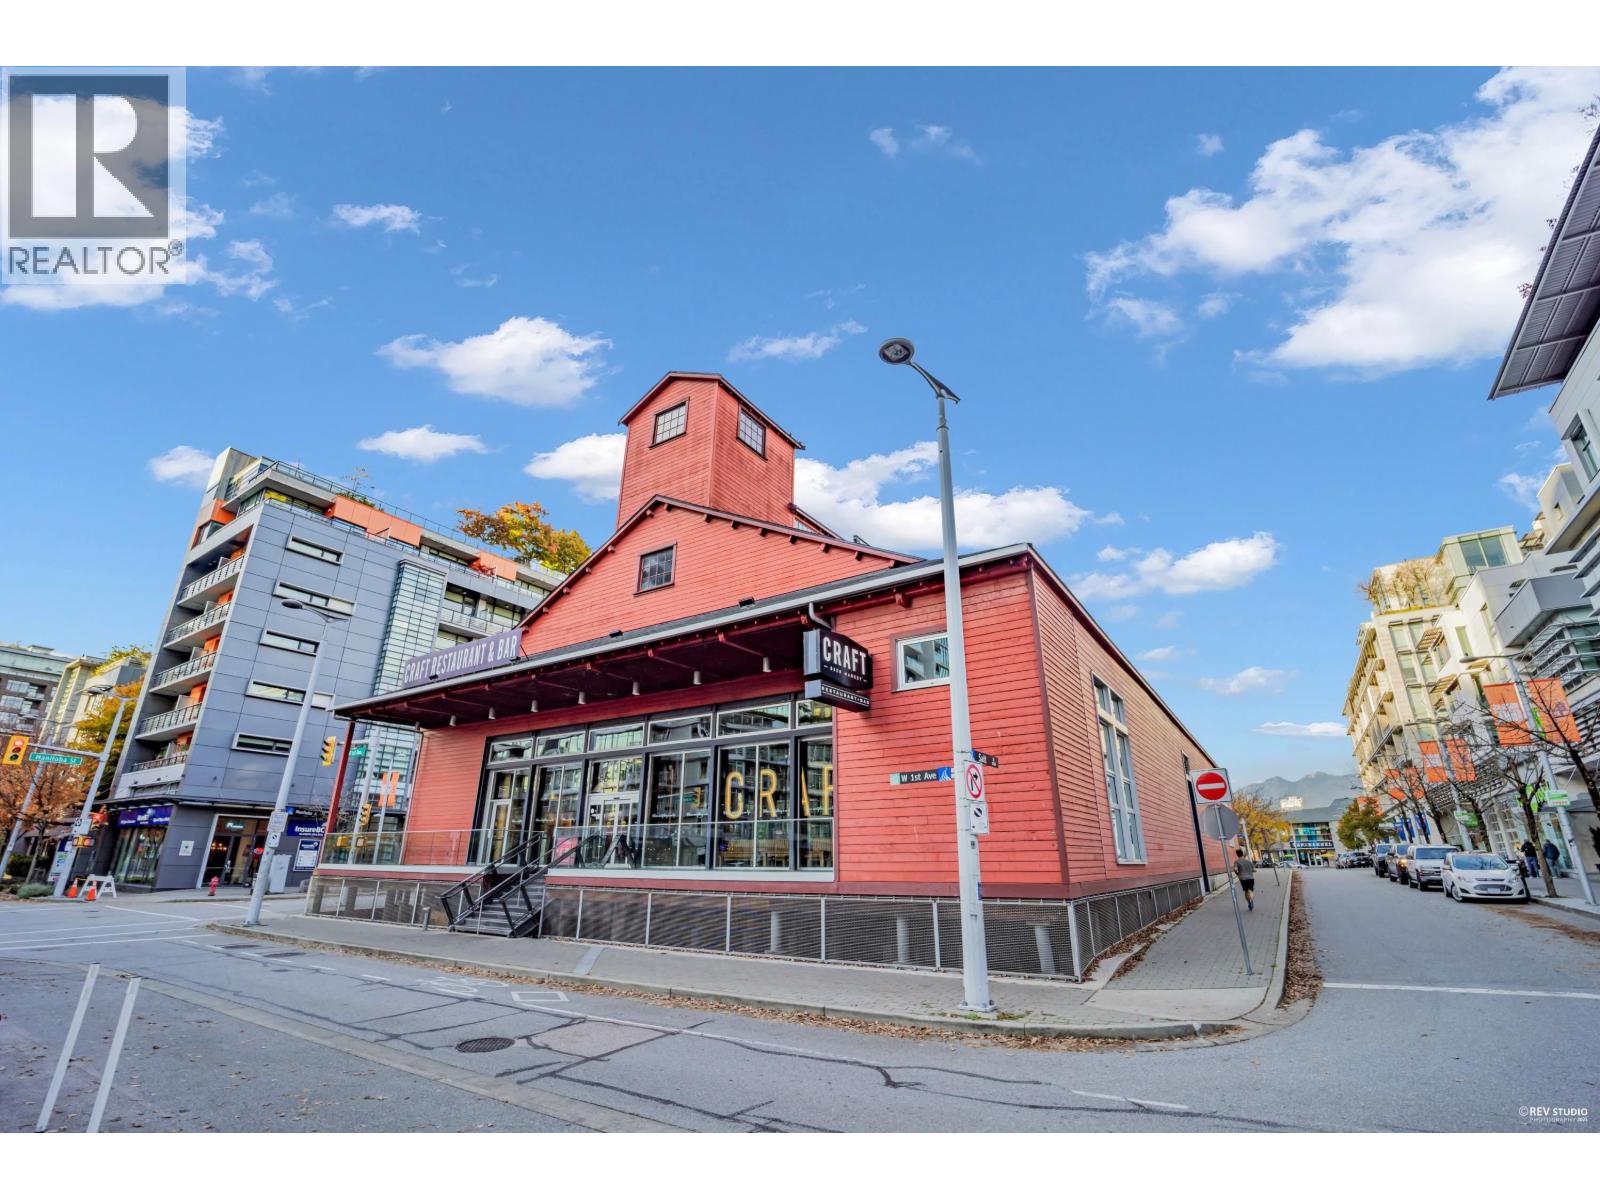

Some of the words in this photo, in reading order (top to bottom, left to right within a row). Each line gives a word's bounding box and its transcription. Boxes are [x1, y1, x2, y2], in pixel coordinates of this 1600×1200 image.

[404, 658, 431, 683] CRAFT
[430, 643, 487, 676] RESTAURANT
[487, 641, 495, 662] &
[497, 635, 518, 660] BAR
[823, 636, 867, 675] CRAFT
[35, 754, 67, 762] Manitoba
[910, 773, 921, 781] 1st
[924, 772, 937, 780] Ave
